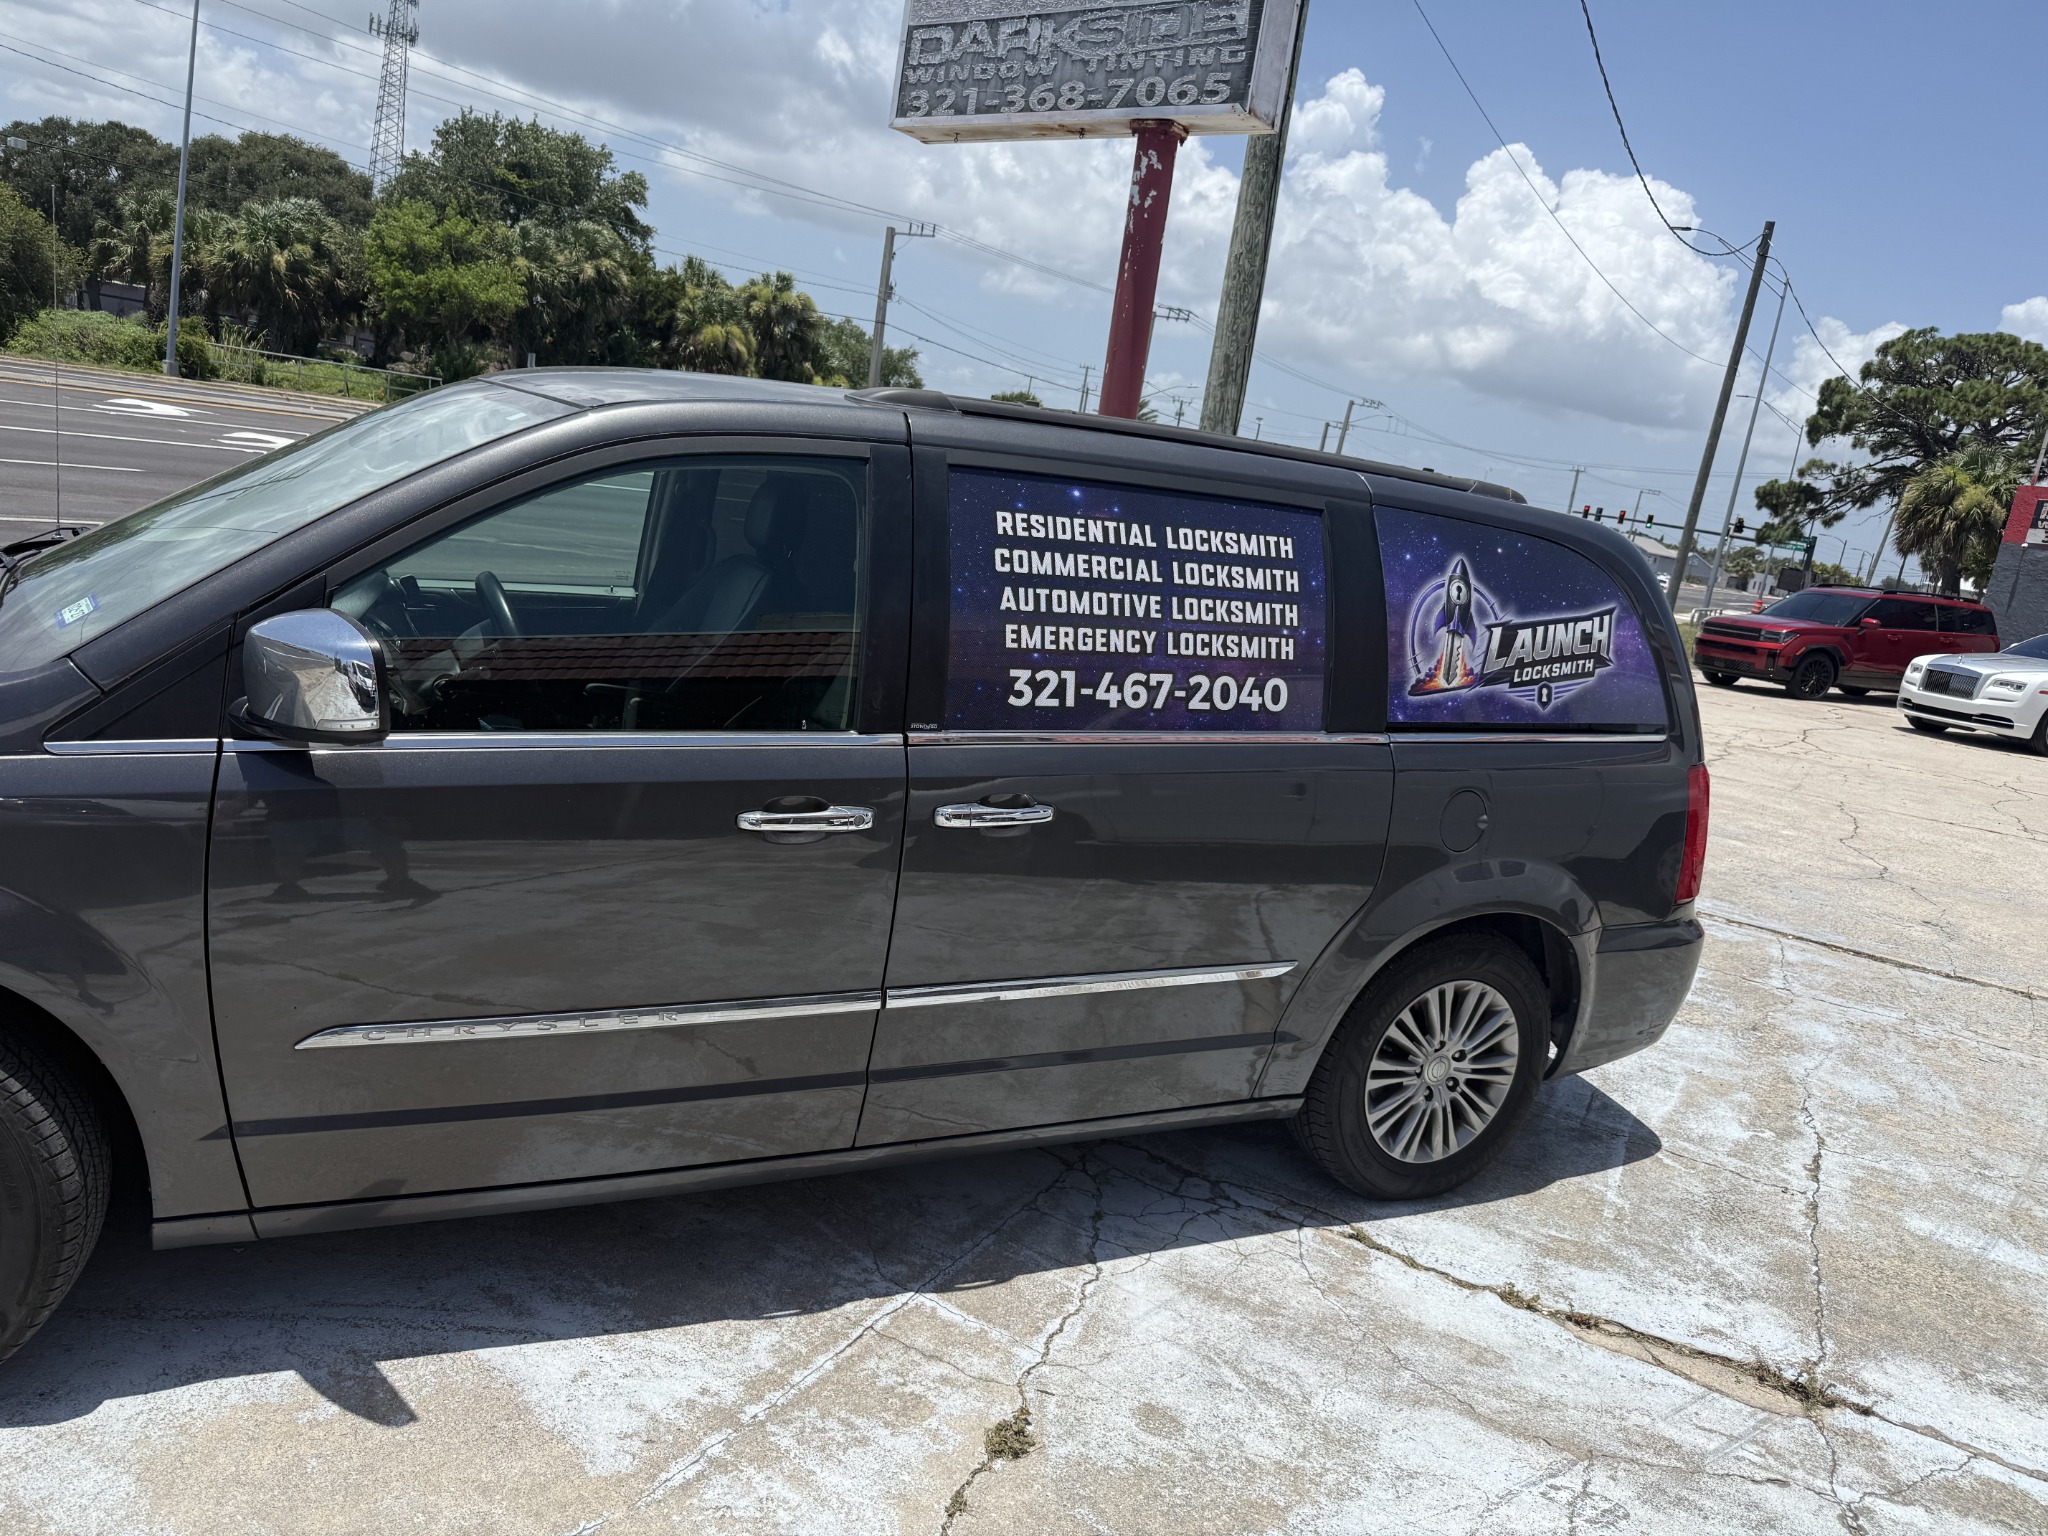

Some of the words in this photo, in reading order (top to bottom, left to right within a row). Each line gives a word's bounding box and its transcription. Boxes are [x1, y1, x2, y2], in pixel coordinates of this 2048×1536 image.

[904, 57, 1058, 85] WINDOW
[1074, 45, 1247, 72] TINTING
[905, 71, 1232, 118] 321-368-7065
[995, 510, 1157, 548] RESIDENTIAL
[1165, 526, 1294, 559] LOCKSMITH
[994, 548, 1163, 583] COMMERCIAL
[1172, 561, 1299, 592] LOCKSMITH
[1000, 586, 1162, 619] AUTOMOTIVE
[1171, 597, 1298, 627] LOCKSMITH
[1005, 624, 1157, 654] EMERGENCY
[1167, 632, 1294, 660] LOCKSMITH
[1484, 613, 1613, 674] LAUNCH
[1007, 668, 1288, 712] 321-467-2040
[1513, 658, 1594, 683] LOCKSMITH
[362, 1011, 679, 1041] CHRYSLER
